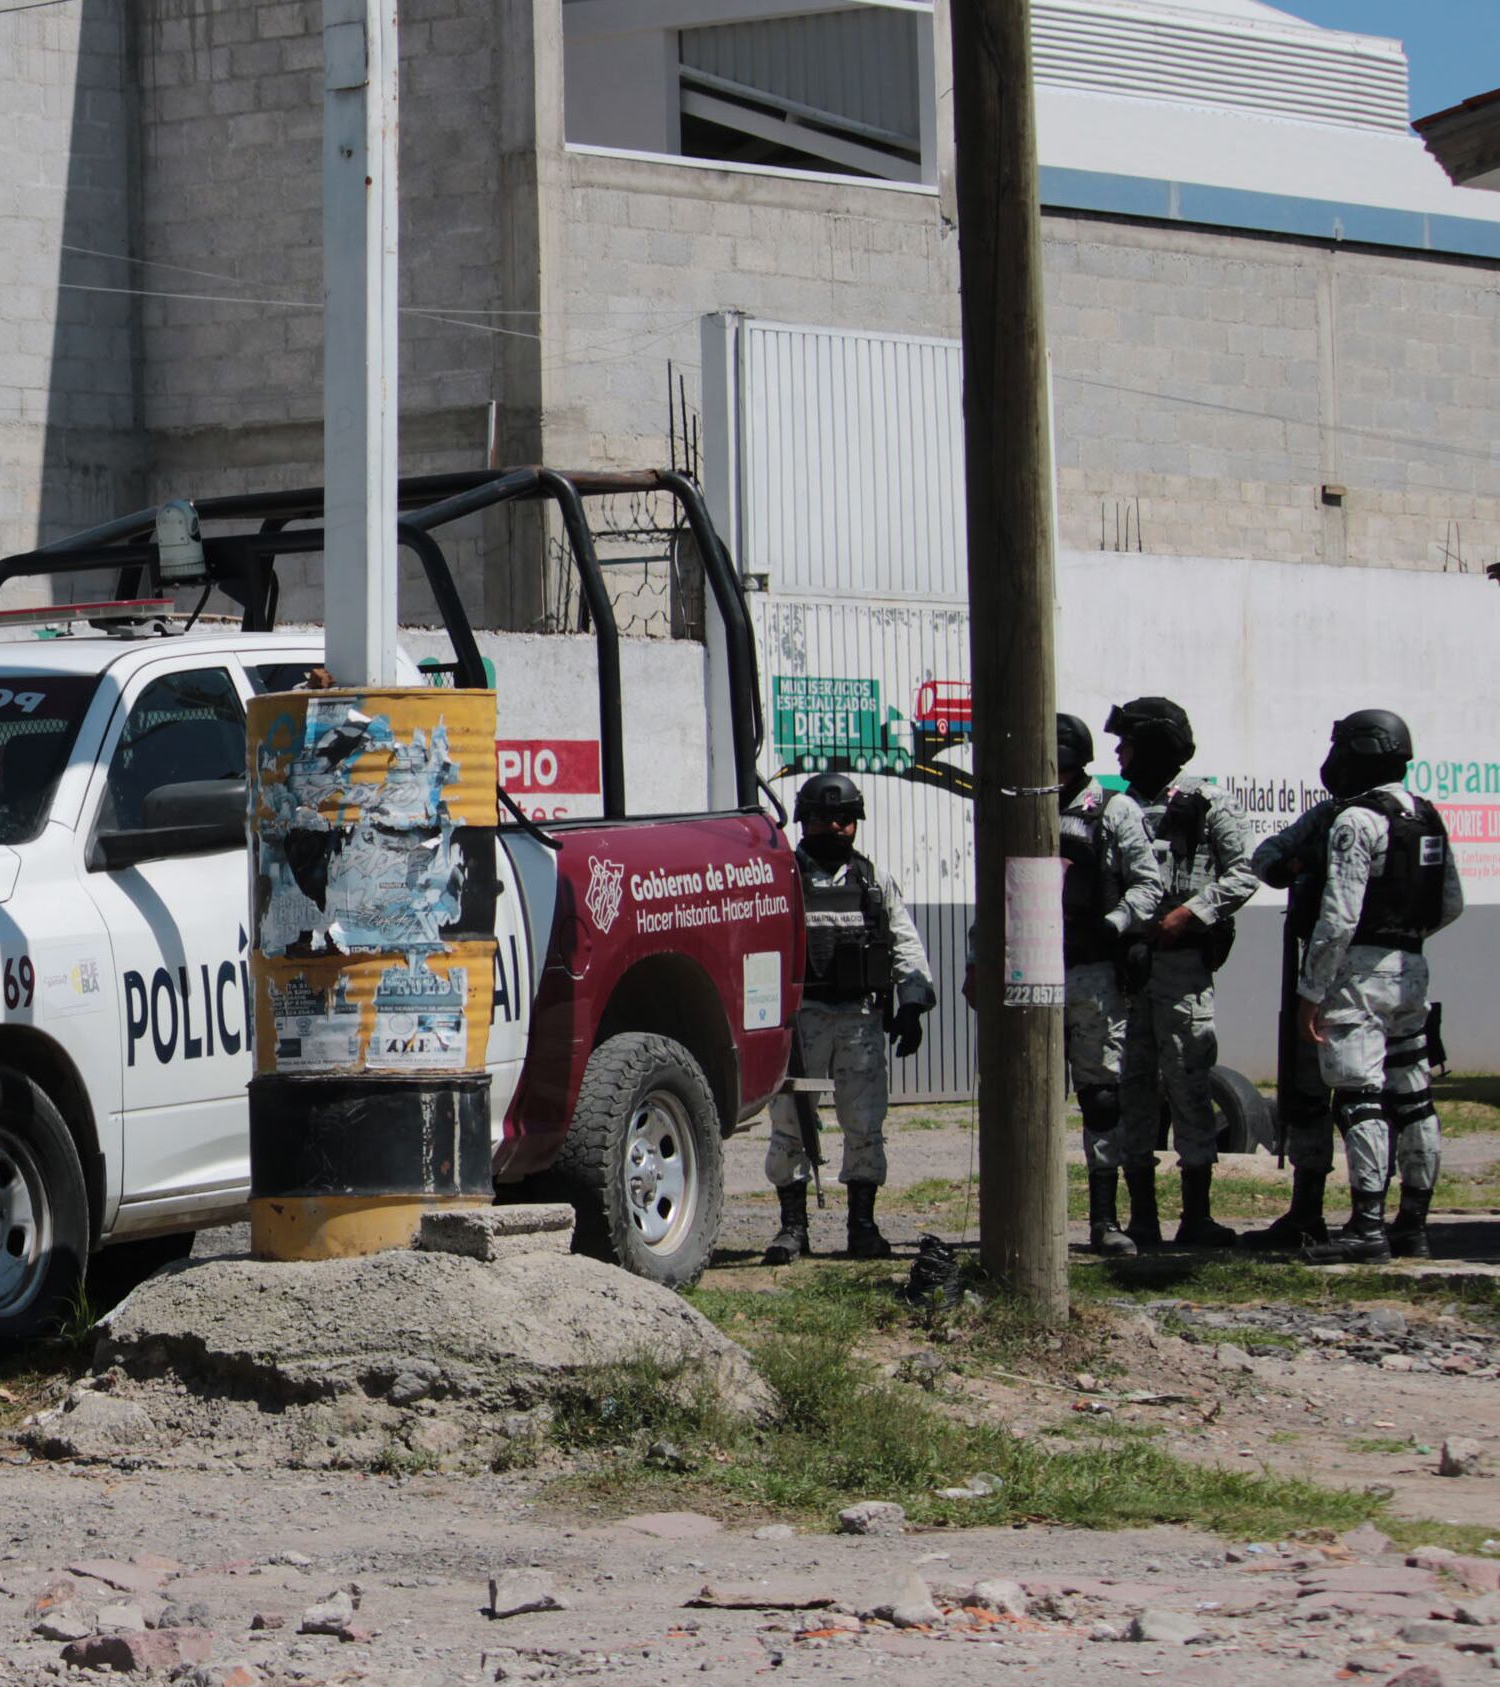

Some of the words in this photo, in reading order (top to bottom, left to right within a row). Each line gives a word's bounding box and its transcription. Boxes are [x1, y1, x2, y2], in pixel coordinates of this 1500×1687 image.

[794, 711, 860, 738] DIESEL
[1279, 780, 1295, 813] de
[630, 867, 702, 902] Gobierno
[705, 863, 724, 892] de
[725, 857, 774, 889] Puebla
[636, 906, 674, 934] Hacer
[722, 897, 753, 922] Hacer
[123, 921, 252, 1067] POLICÍ
